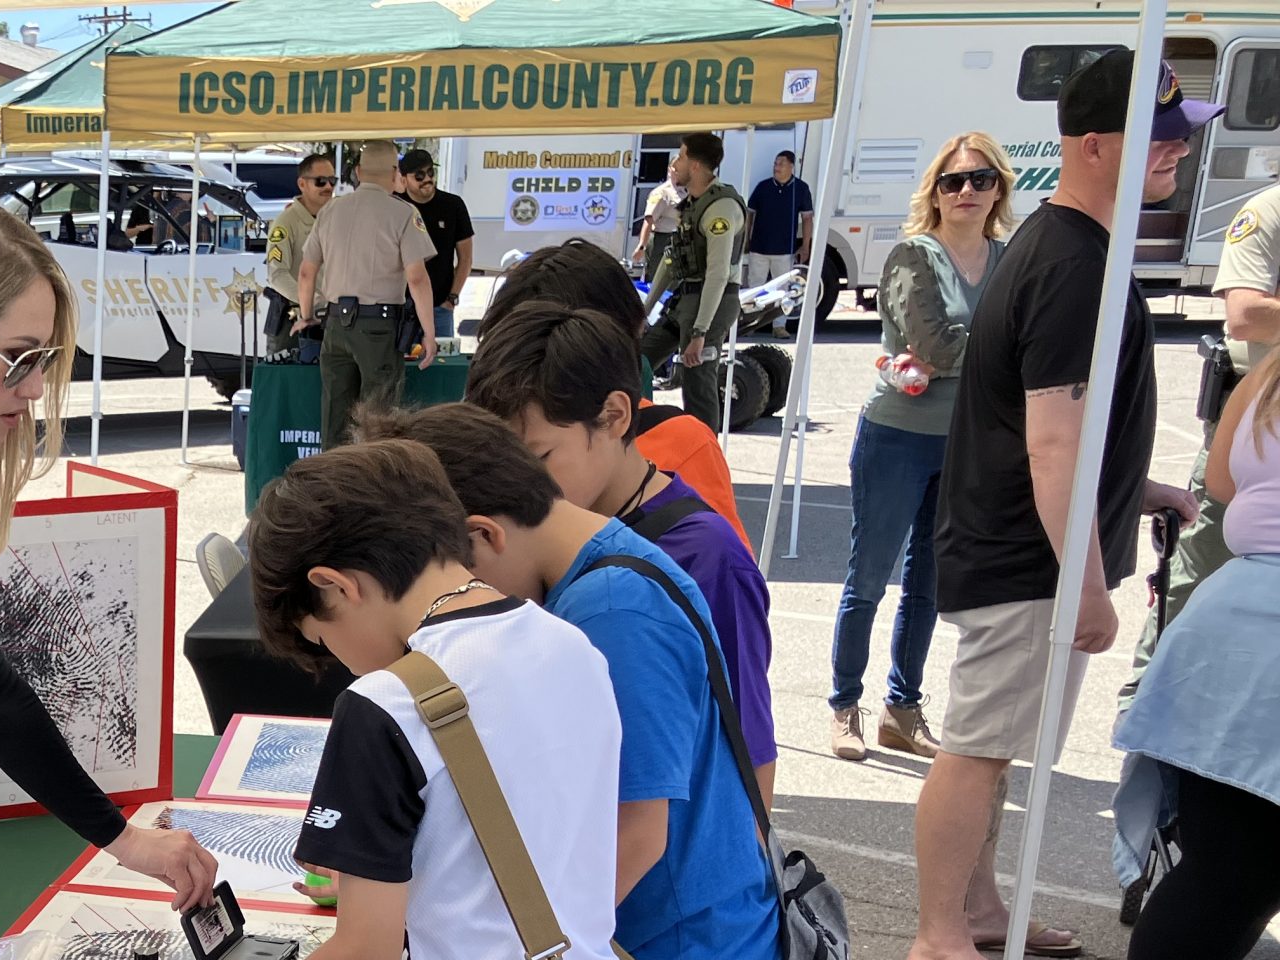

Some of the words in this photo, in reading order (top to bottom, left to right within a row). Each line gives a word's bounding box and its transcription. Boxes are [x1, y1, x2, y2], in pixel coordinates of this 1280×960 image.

[178, 56, 754, 115] ICSO.IMPERIALCOUNTY.ORG
[1041, 141, 1062, 158] Co
[483, 151, 537, 169] Mobile
[540, 150, 620, 169] Command
[512, 177, 582, 193] CHILD
[587, 177, 615, 192] ID
[163, 305, 200, 318] Couny
[280, 430, 322, 444] IMPERI
[96, 512, 138, 526] LATENT
